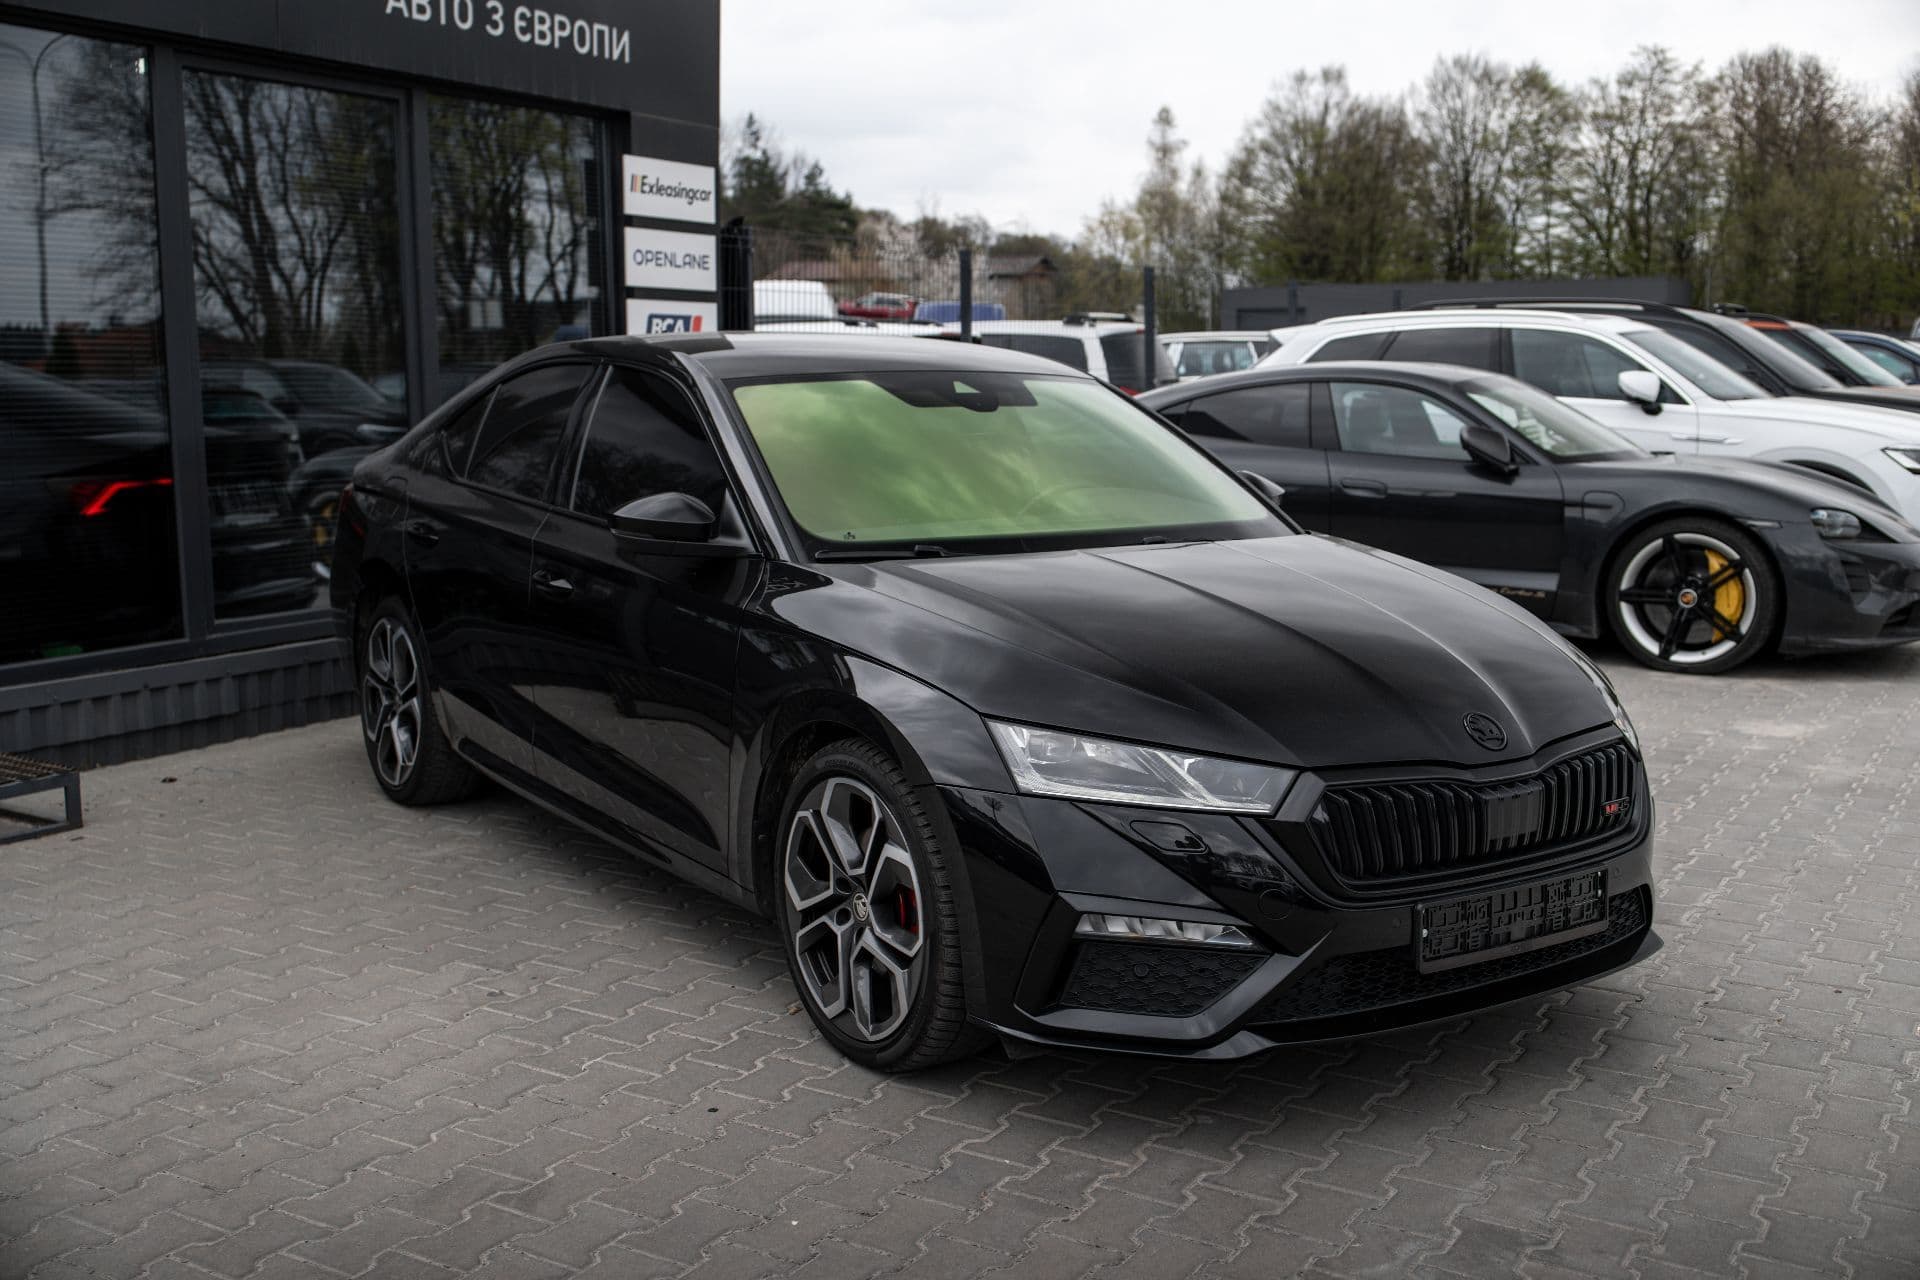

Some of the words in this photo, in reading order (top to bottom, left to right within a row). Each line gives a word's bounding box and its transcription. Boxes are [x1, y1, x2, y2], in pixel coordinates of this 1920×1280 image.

[485, 0, 505, 37] З
[513, 6, 630, 63] ЄВРОПИ
[641, 175, 712, 205] Exleasingcar
[633, 248, 710, 270] OPENLANE
[650, 317, 686, 335] BCA
